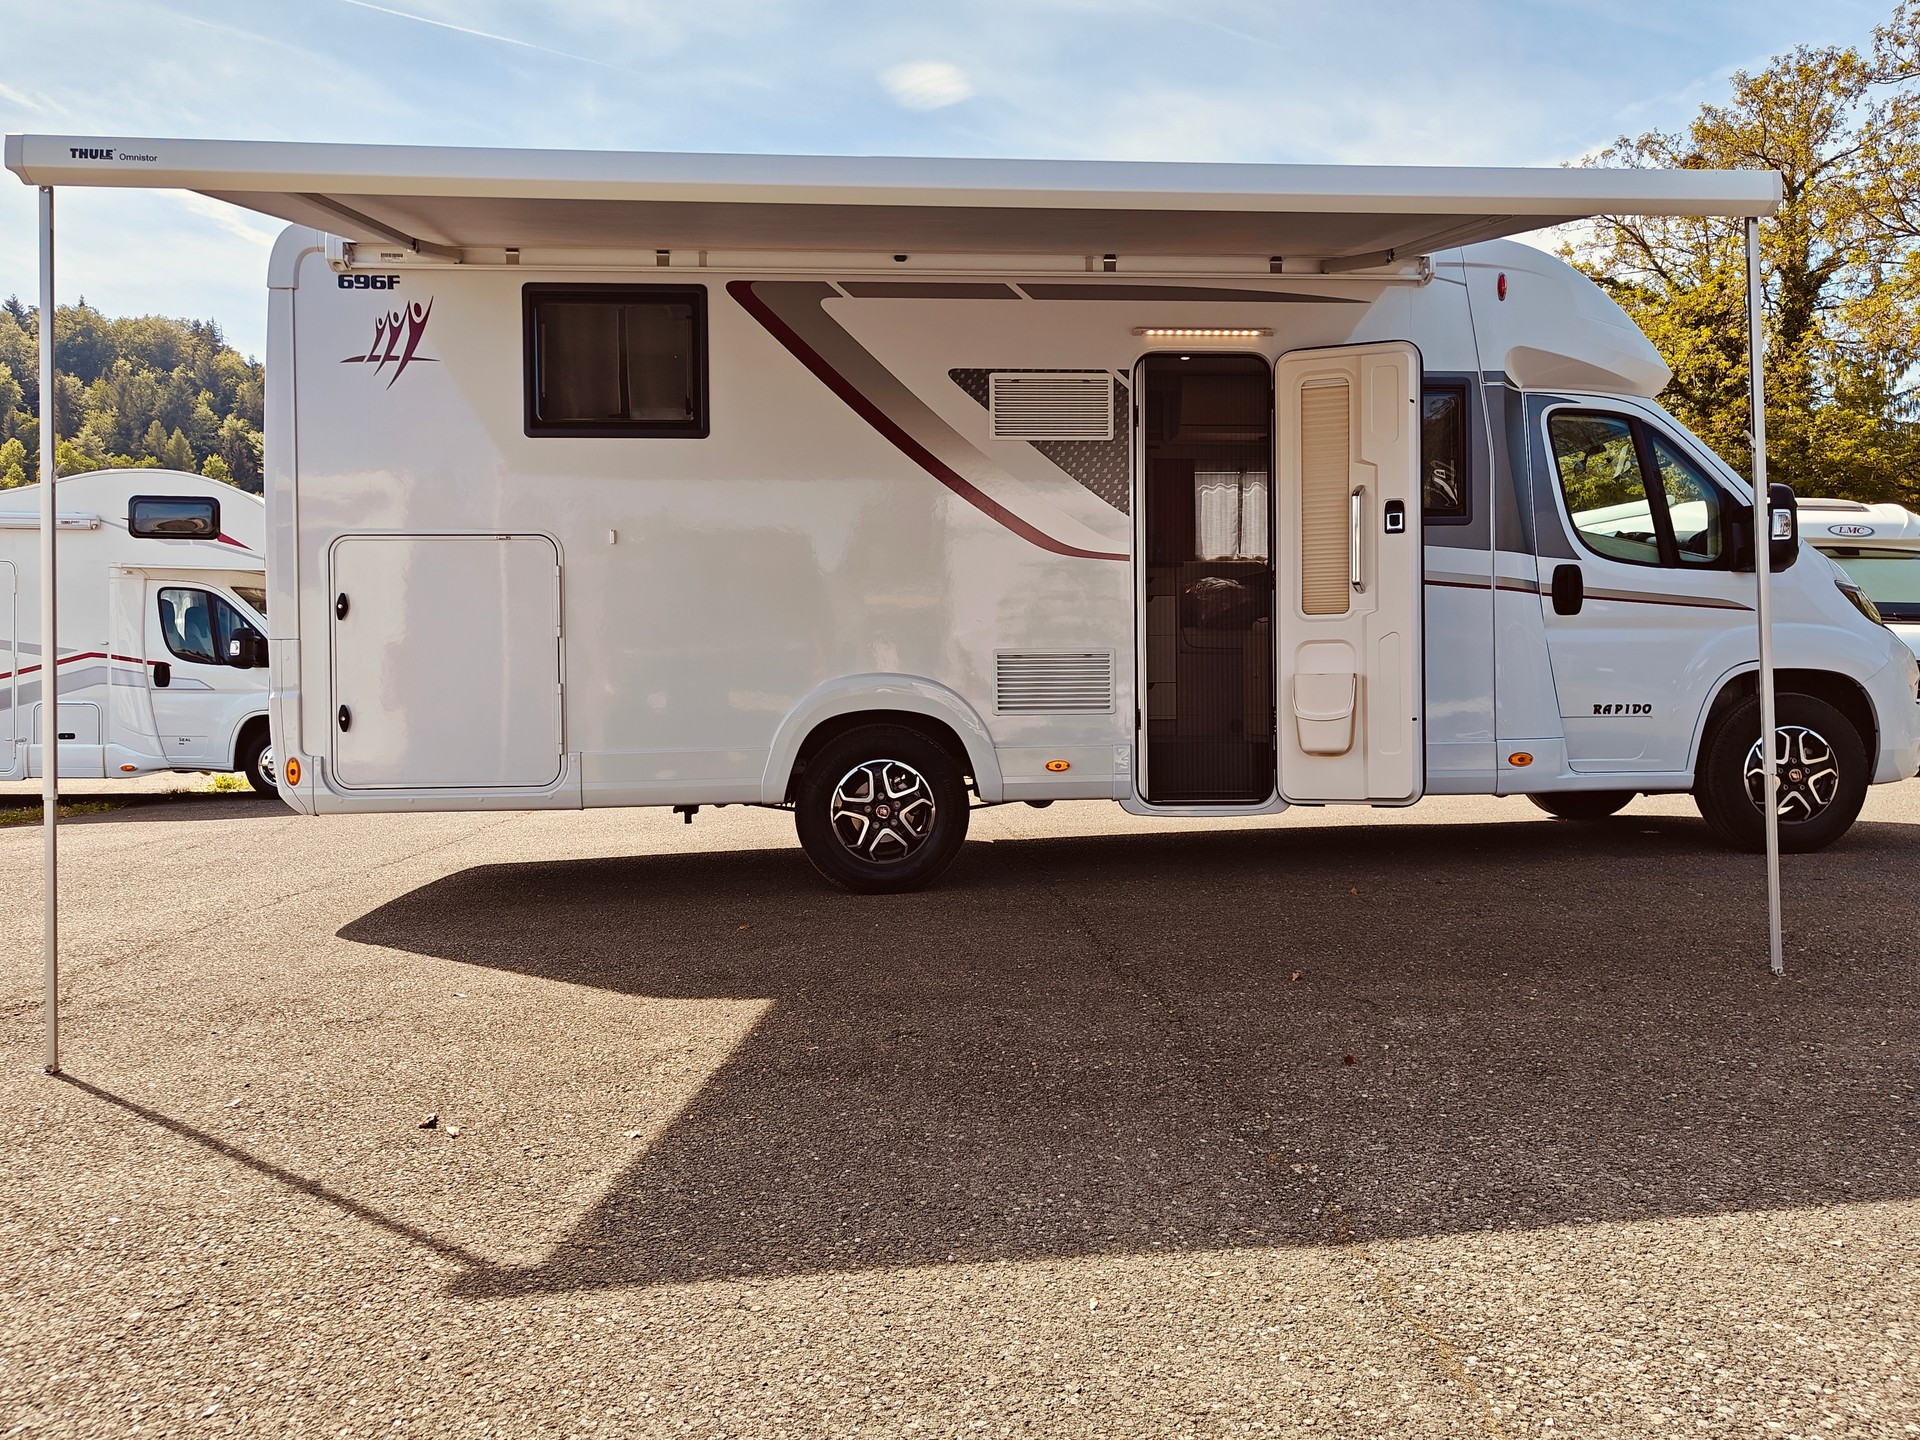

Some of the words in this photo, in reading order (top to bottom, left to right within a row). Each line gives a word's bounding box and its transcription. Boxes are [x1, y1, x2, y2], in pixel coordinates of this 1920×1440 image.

[70, 148, 114, 160] THULE
[119, 153, 158, 162] Omnistor
[338, 275, 400, 290] 696F
[1838, 526, 1865, 535] LMC
[1593, 704, 1652, 715] RAPIDO
